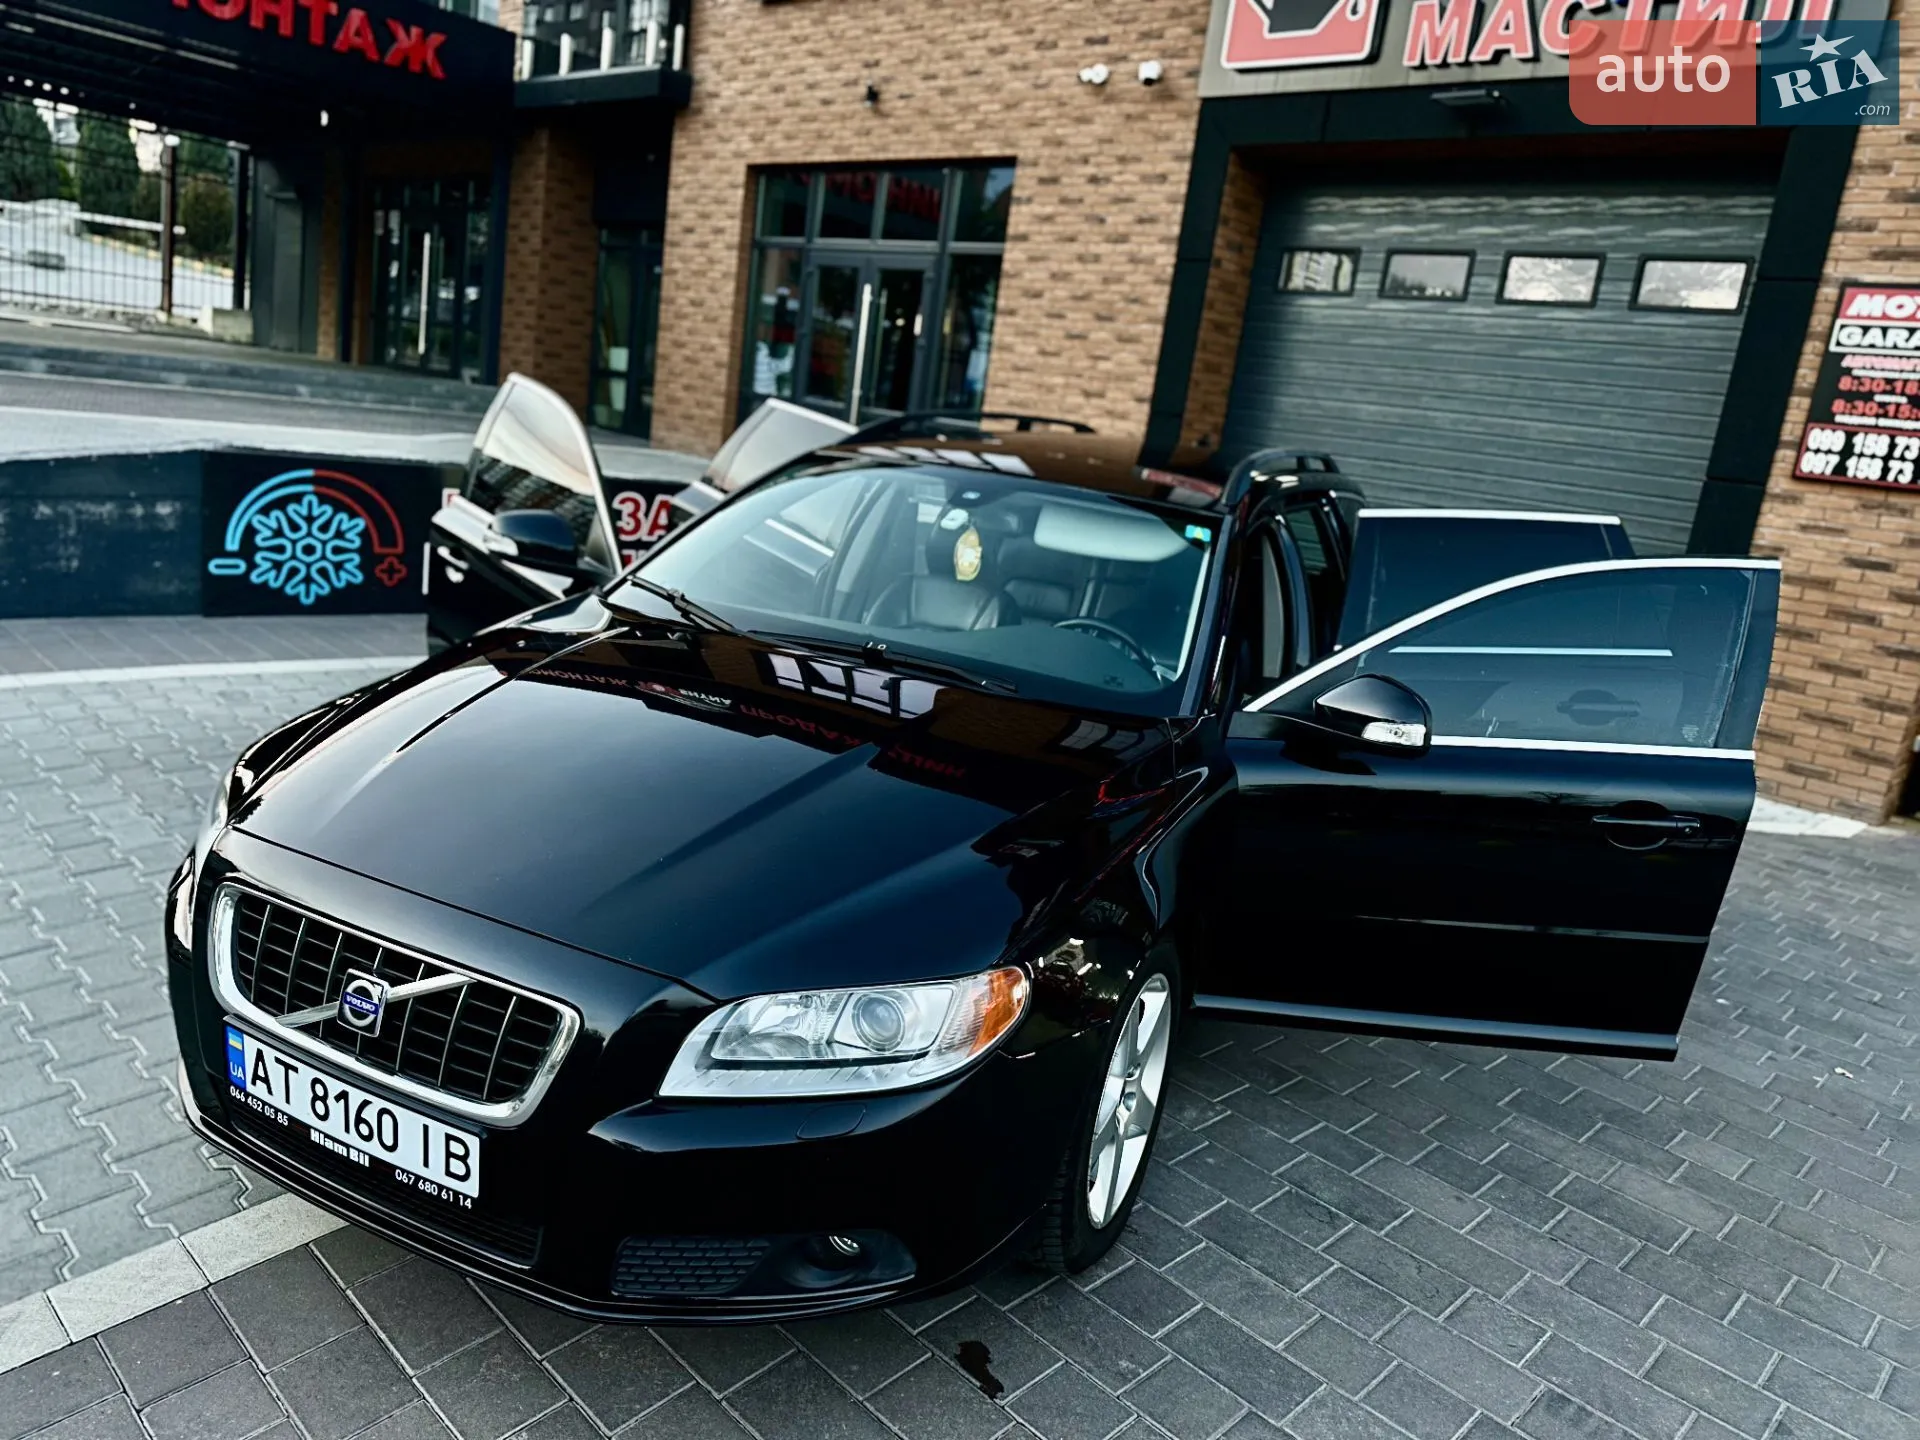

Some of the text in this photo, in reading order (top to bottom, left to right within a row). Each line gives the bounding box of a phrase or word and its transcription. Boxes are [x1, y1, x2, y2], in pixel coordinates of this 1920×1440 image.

[172, 0, 448, 80] ОНТАЖ
[1892, 435, 1920, 461] 73
[1886, 459, 1915, 484] 73
[346, 994, 376, 1012] VOLVO
[229, 1062, 245, 1080] UA
[229, 1085, 289, 1126] 066 452 05 85
[250, 1047, 472, 1183] AT 8160 IB
[395, 1169, 473, 1210] 067 680 61 14
